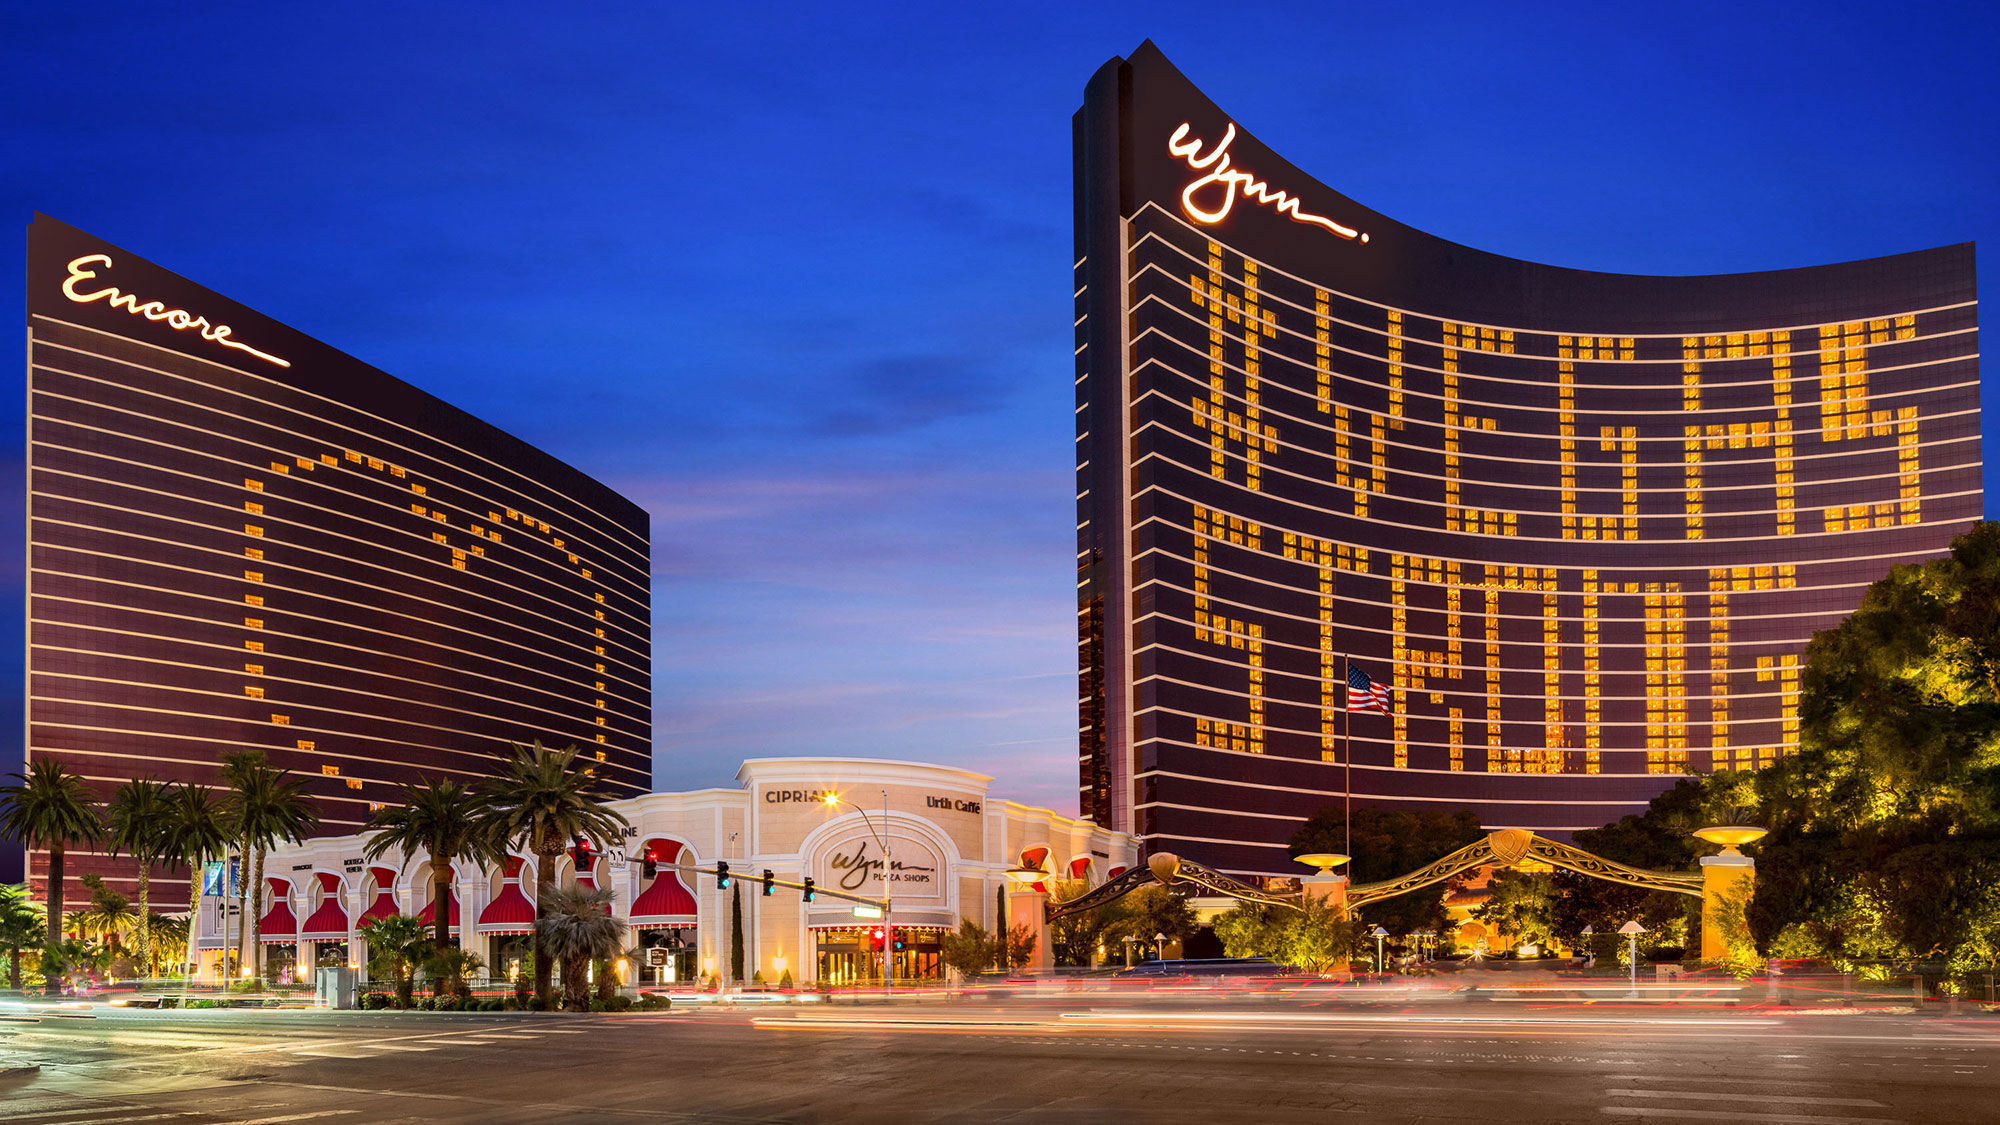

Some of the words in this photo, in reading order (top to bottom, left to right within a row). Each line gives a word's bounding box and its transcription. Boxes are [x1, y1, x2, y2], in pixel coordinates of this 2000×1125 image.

[62, 253, 292, 369] Encore
[1191, 240, 1920, 541] #VEGAS
[1194, 503, 1800, 774] STRONG
[765, 789, 838, 804] CIPRIA
[926, 795, 952, 810] Urth
[873, 873, 901, 882] PLZA
[904, 873, 930, 883] SHOPS
